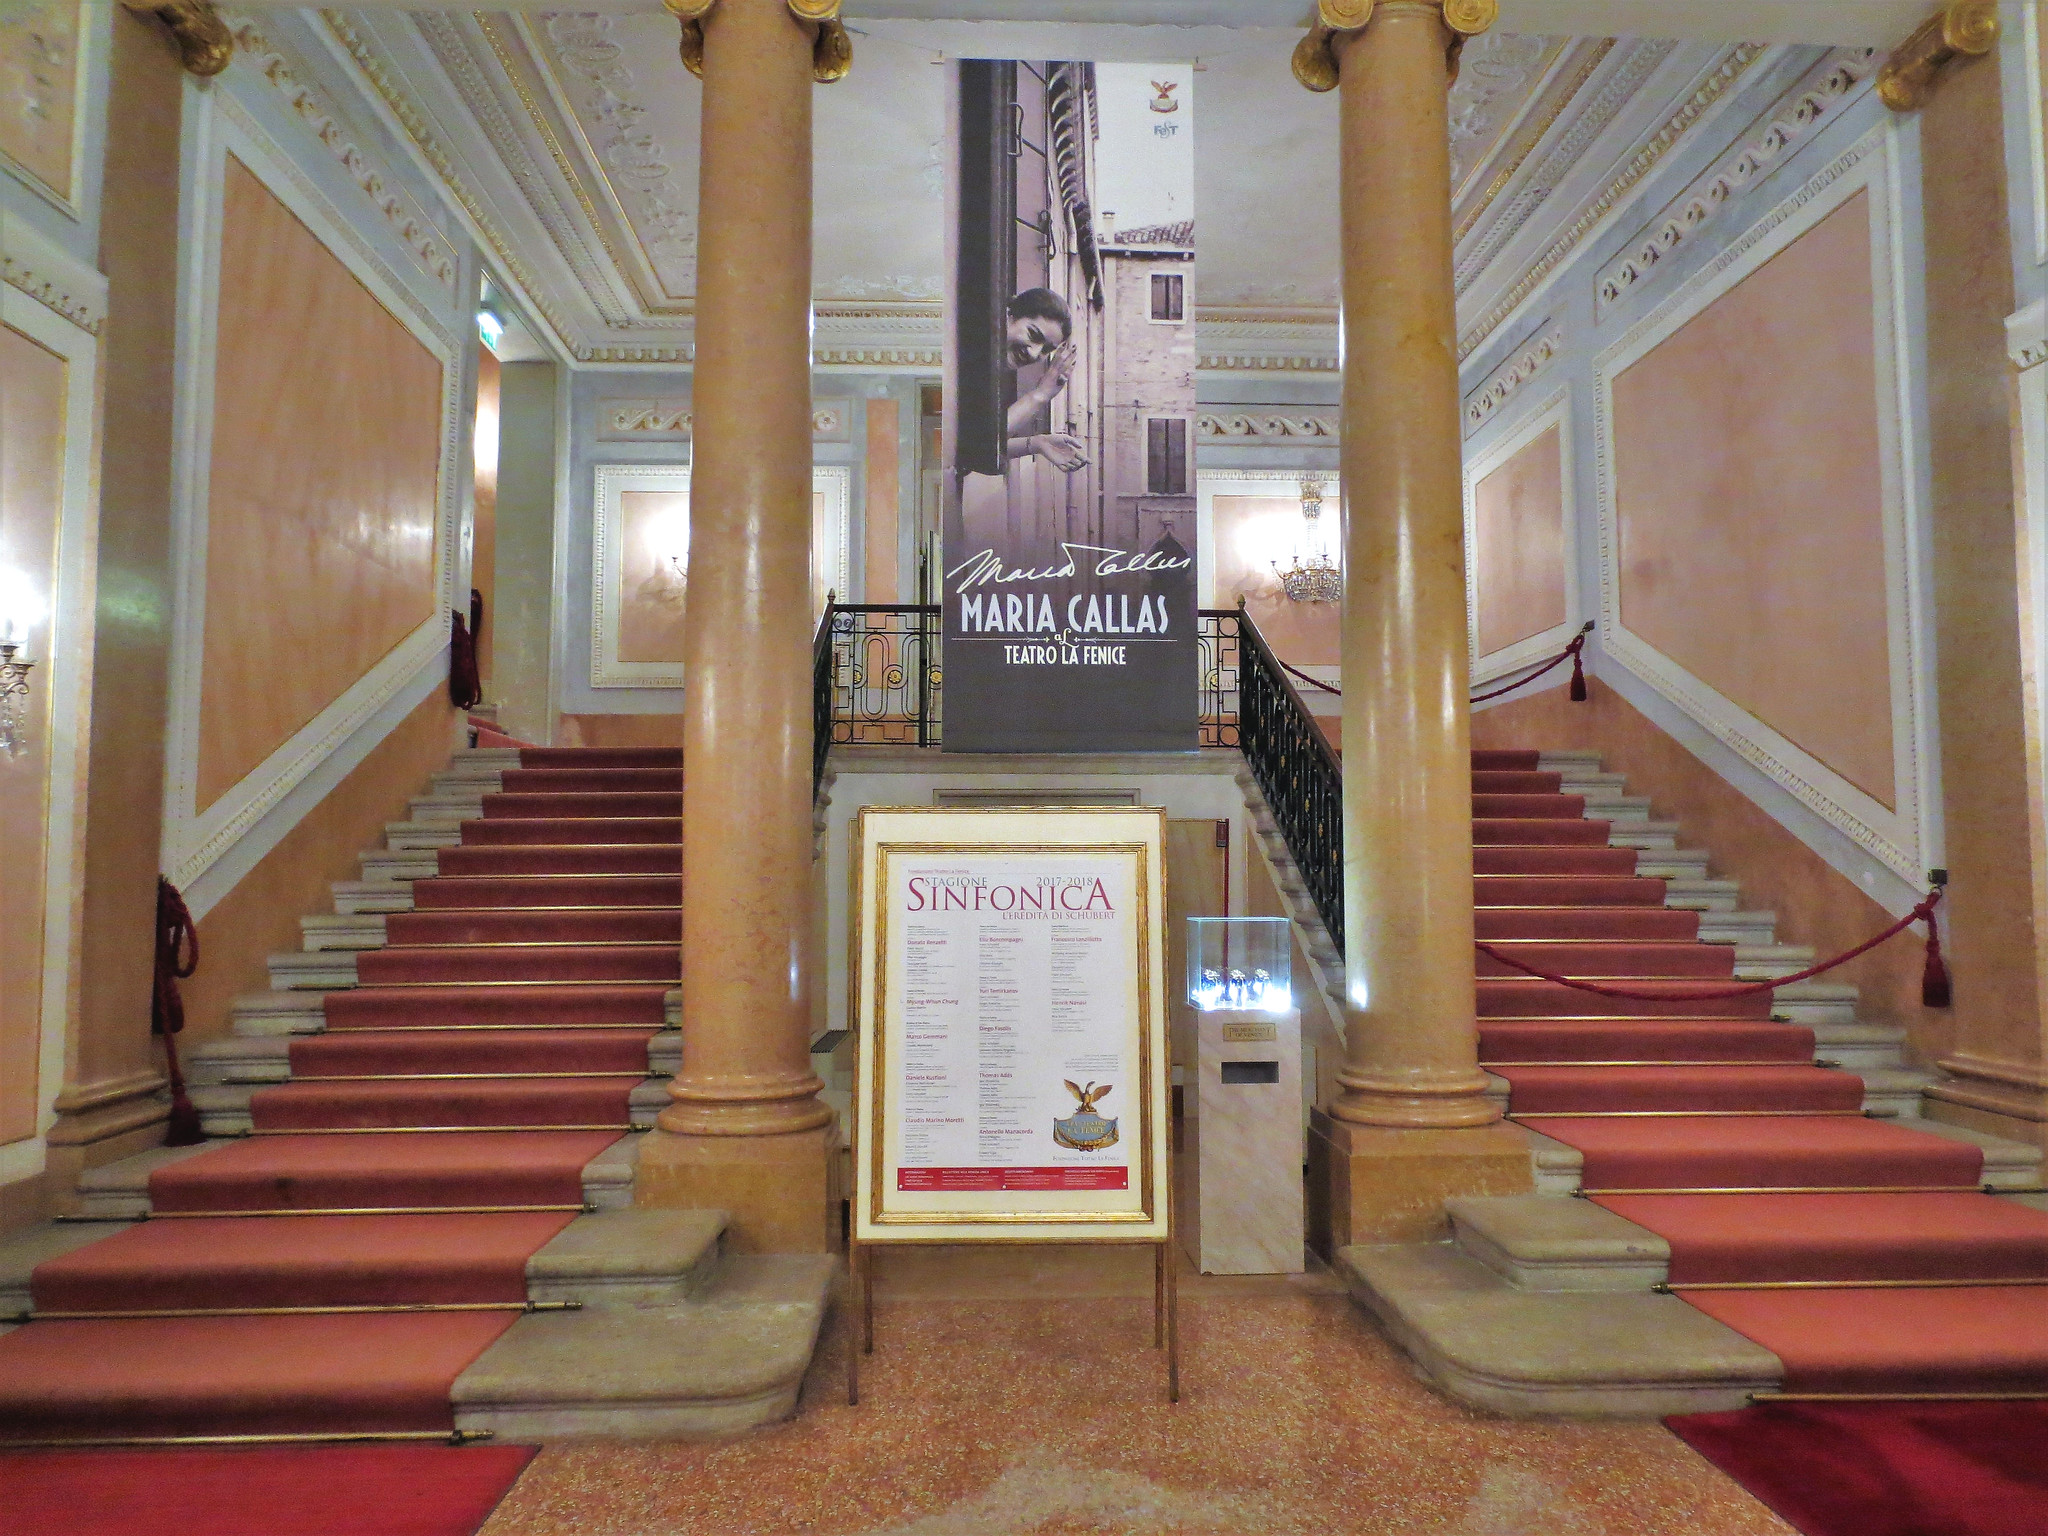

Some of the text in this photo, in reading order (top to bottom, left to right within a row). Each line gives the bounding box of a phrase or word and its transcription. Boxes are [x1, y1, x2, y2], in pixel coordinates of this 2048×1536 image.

[961, 593, 1170, 634] MARIA CALLAS
[1004, 645, 1127, 665] TEATRO LA FENICE
[924, 876, 1093, 887] STAGIONE 2017-2018
[907, 877, 1115, 911] SINFONICA
[1065, 911, 1116, 920] SCHUBERT
